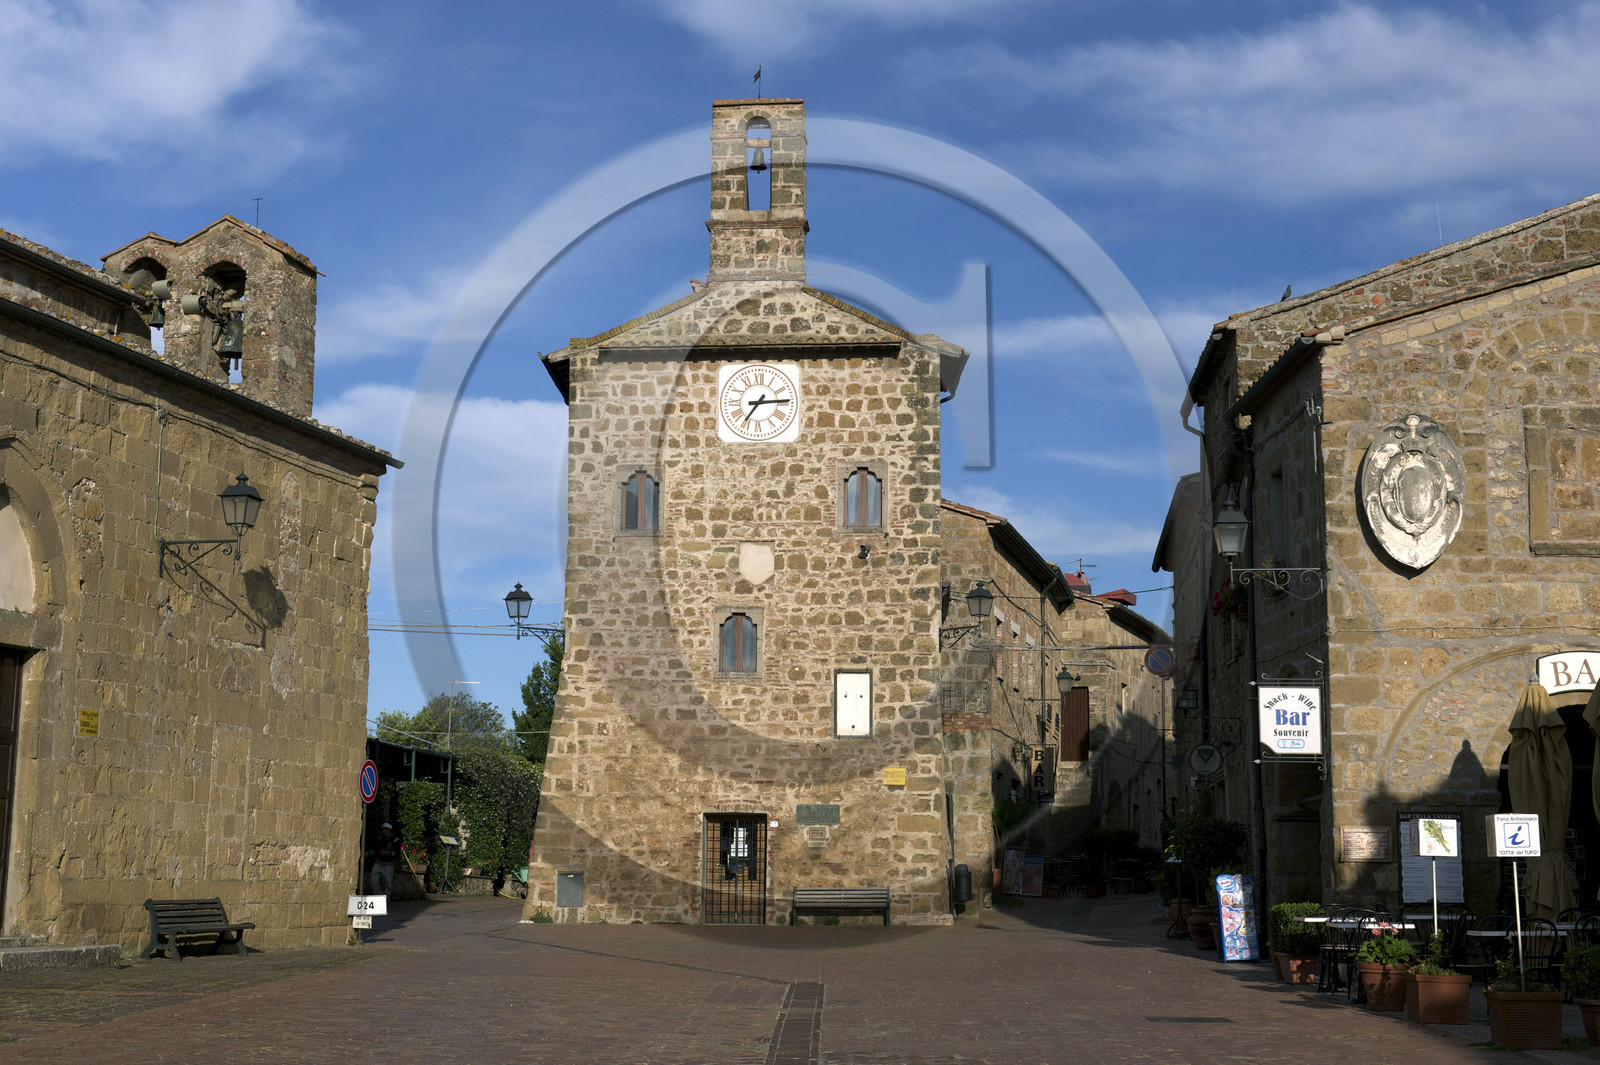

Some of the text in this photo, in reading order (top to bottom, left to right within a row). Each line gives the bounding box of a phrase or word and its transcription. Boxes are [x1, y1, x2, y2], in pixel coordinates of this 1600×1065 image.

[1263, 692, 1289, 711] Snack
[1297, 693, 1317, 711] Wine
[1275, 708, 1310, 726] Bar
[1273, 728, 1309, 737] Souvenir
[1033, 750, 1045, 788] BAR
